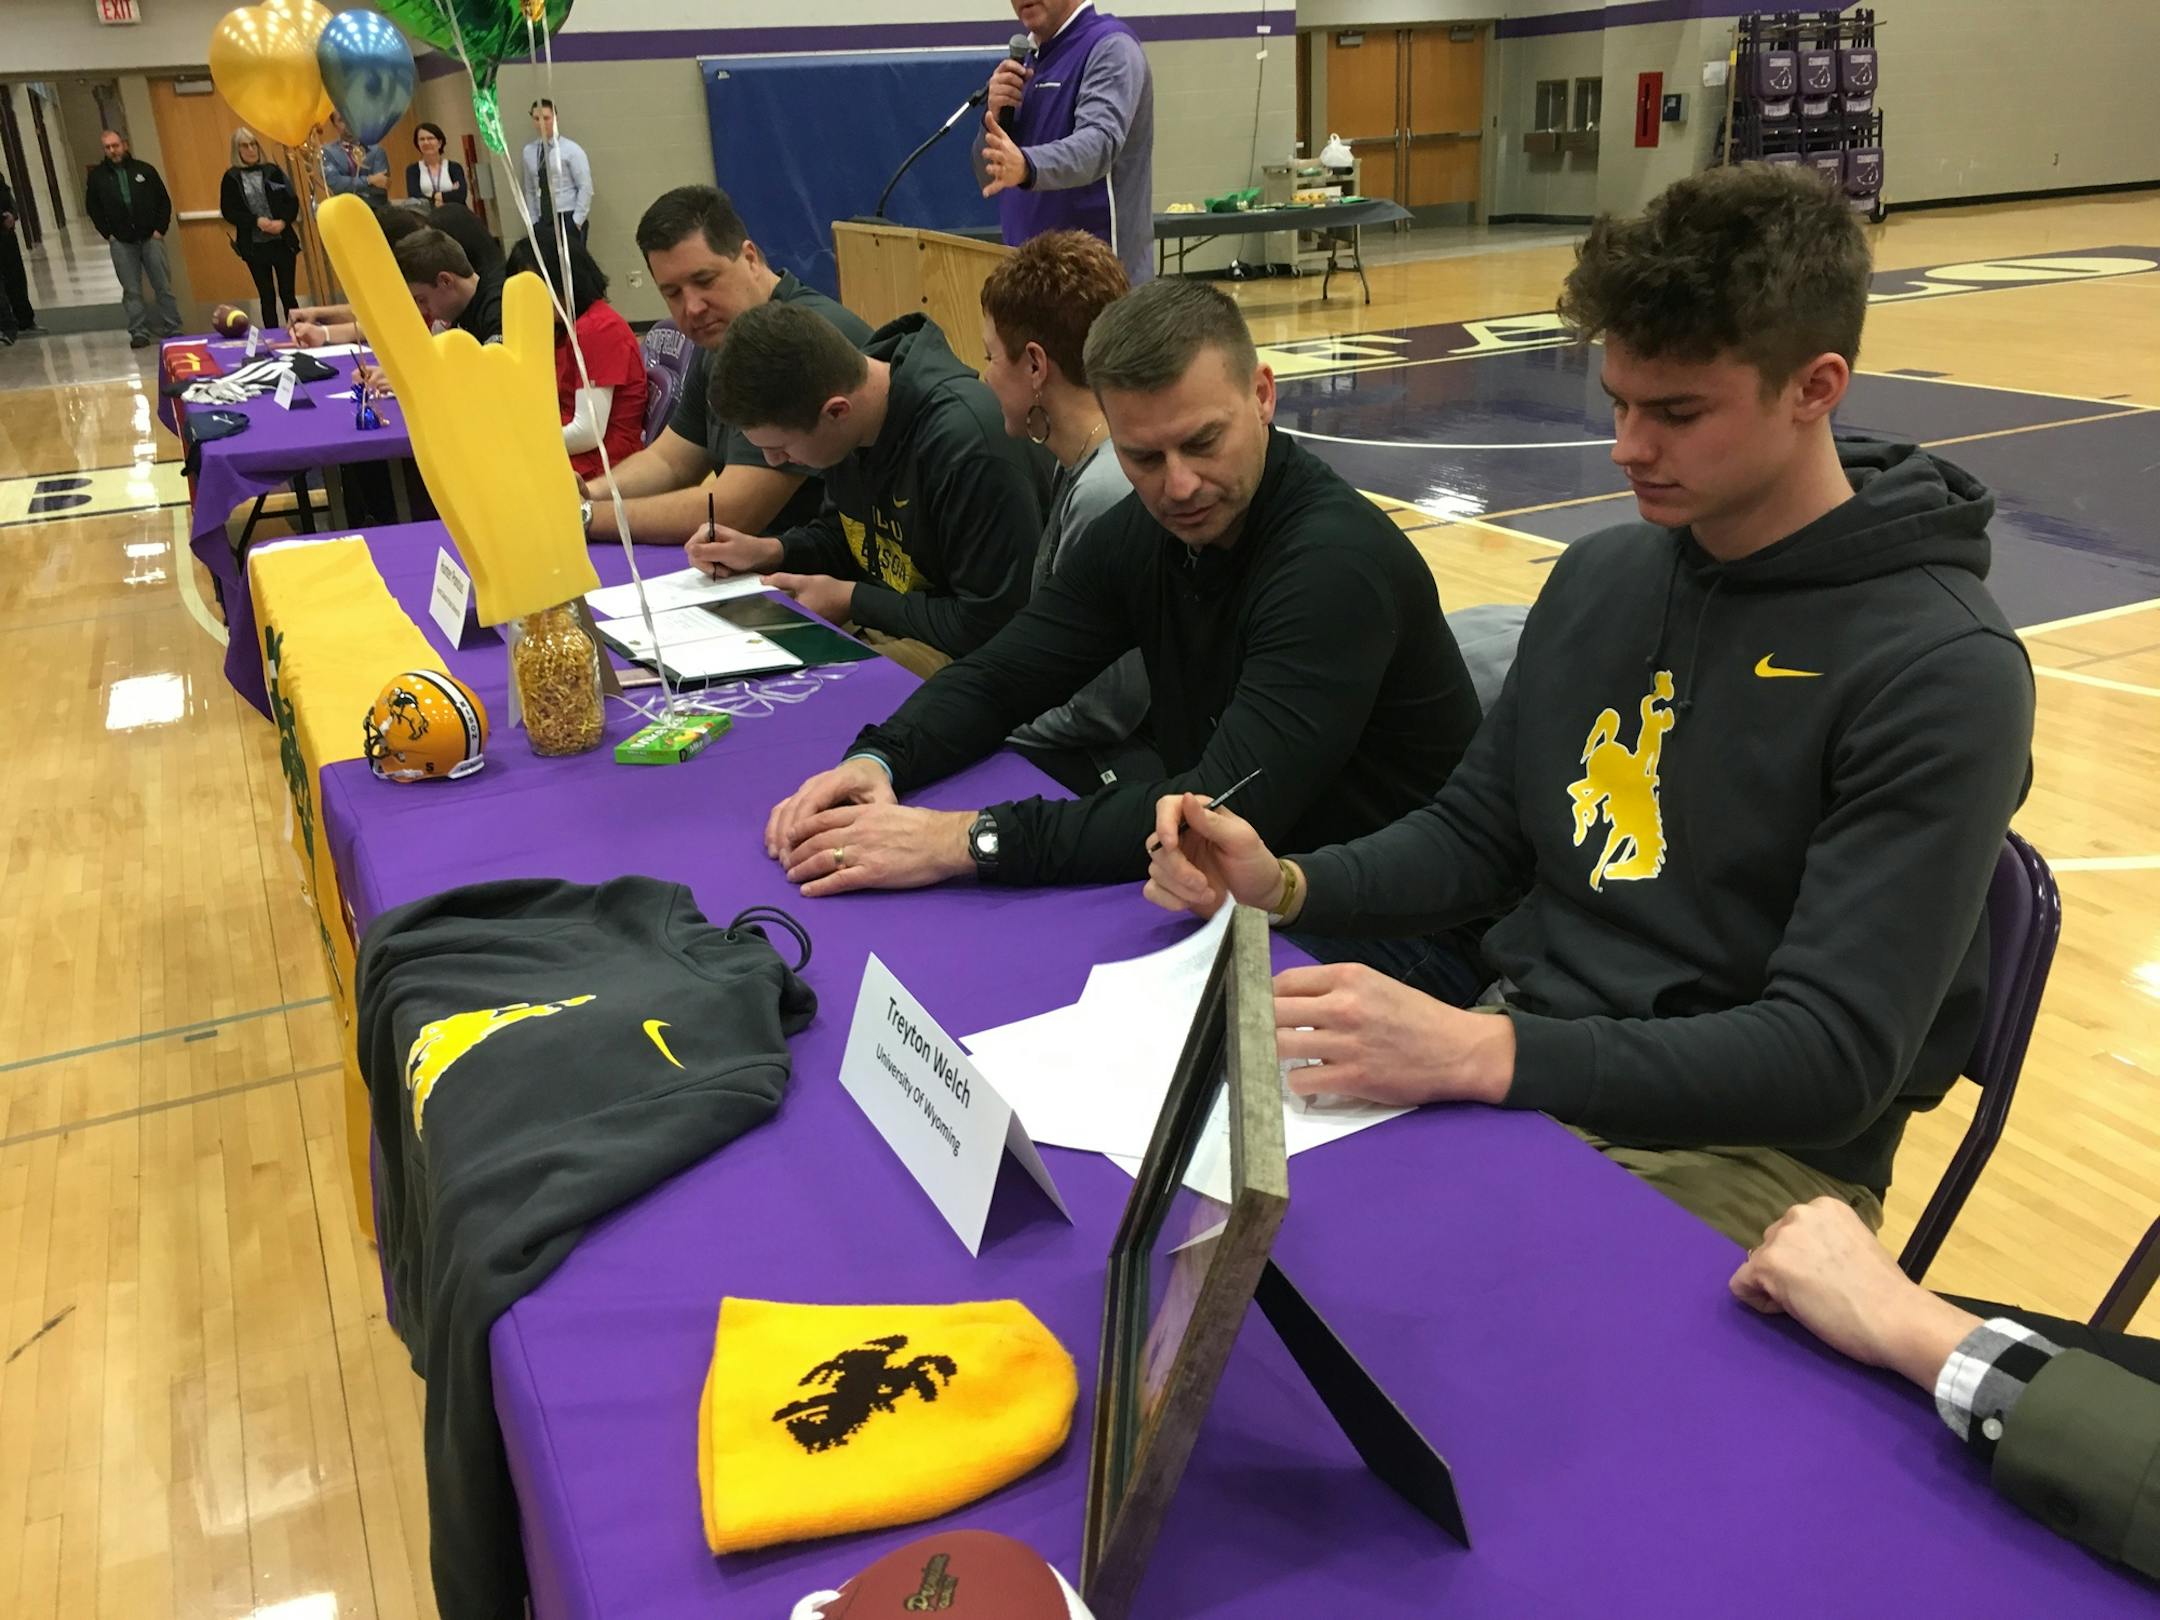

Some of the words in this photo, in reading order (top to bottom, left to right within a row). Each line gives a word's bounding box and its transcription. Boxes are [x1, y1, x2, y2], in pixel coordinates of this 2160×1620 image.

[102, 0, 132, 20] EXIT
[876, 1043, 913, 1098] University
[913, 1087, 924, 1107] Of
[923, 1103, 961, 1157] Wyoming
[886, 997, 931, 1062] Treyton
[933, 1047, 971, 1109] Welch
